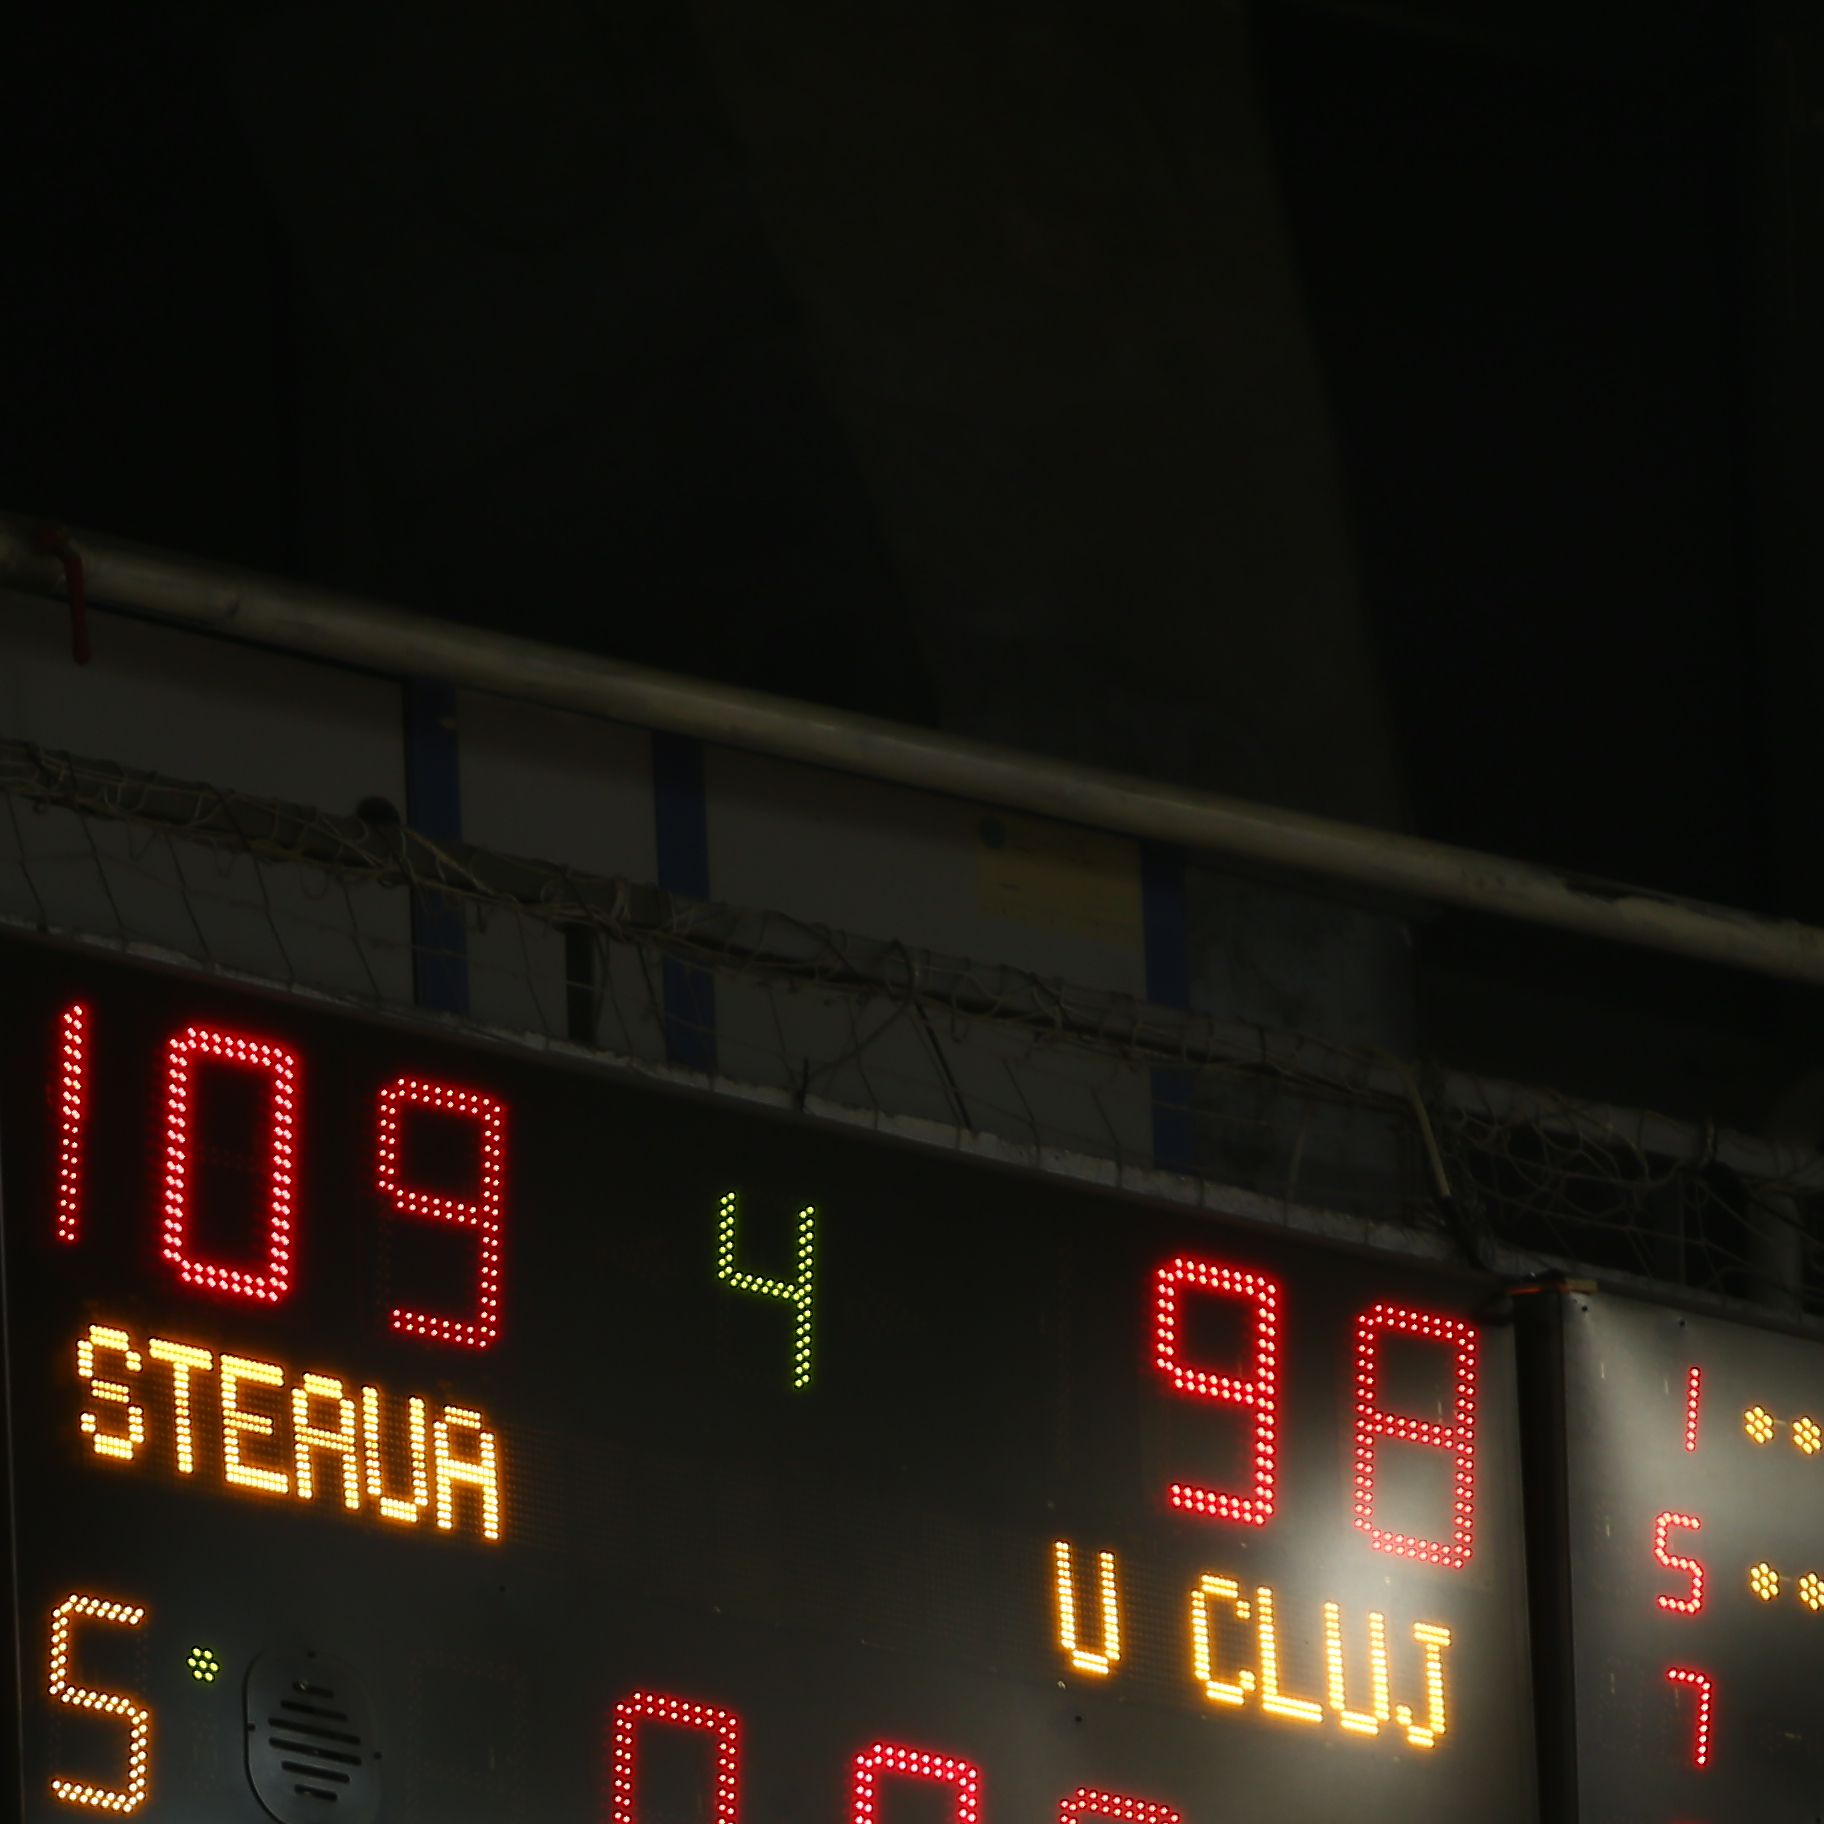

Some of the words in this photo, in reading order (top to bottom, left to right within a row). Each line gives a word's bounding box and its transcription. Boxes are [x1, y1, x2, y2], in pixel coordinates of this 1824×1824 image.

[56, 1002, 505, 1350] 109
[716, 1190, 816, 1389] 4
[74, 1322, 505, 1542] STEAUA
[1153, 1255, 1479, 1570] 98
[1680, 1366, 1704, 1456] 1
[1054, 1540, 1121, 1675] U
[1189, 1573, 1453, 1749] CLUJ
[1649, 1507, 1707, 1617] 5
[46, 1592, 151, 1815] 5
[1663, 1663, 1716, 1769] 7
